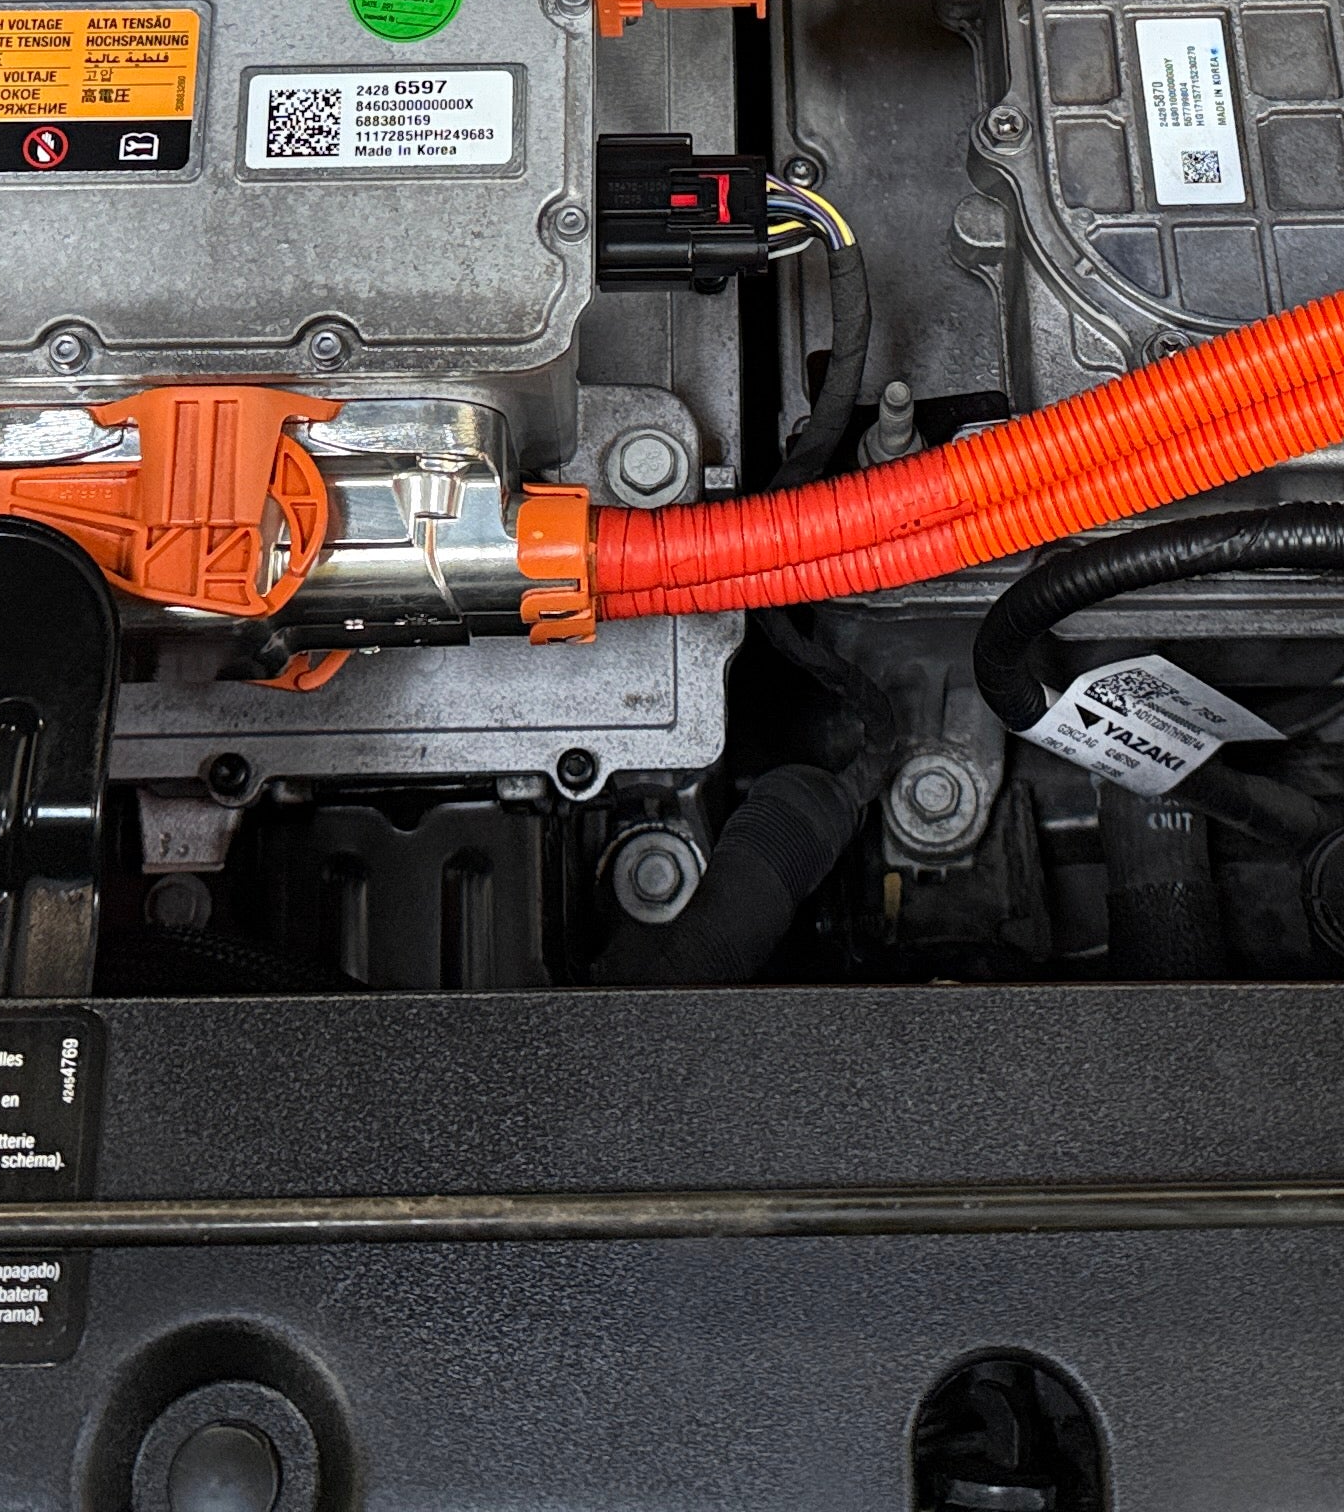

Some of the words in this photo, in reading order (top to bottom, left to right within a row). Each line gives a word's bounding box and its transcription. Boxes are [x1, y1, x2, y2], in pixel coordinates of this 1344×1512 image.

[8, 18, 63, 31] VOLTAGE
[87, 18, 119, 30] ALTA
[122, 15, 171, 29] TENSÃO
[17, 35, 71, 48] TENSION
[86, 35, 189, 47] HOCHSPANNUNG
[3, 70, 57, 83] VOLTAJE
[83, 68, 115, 83] 고압
[1210, 57, 1221, 85] KOREA
[356, 85, 389, 96] 2428
[395, 80, 448, 94] 6597
[1215, 89, 1225, 98] IN
[1215, 101, 1227, 125] MADE
[356, 116, 431, 126] 688380169
[356, 129, 494, 142] 1117285HPH249683
[355, 146, 392, 157] Made
[398, 145, 411, 156] In
[417, 145, 456, 156] Korea
[1104, 720, 1186, 772] YAZAKI
[1147, 811, 1195, 833] OUT
[60, 1038, 79, 1104] 42454769
[1, 1094, 20, 1108] en
